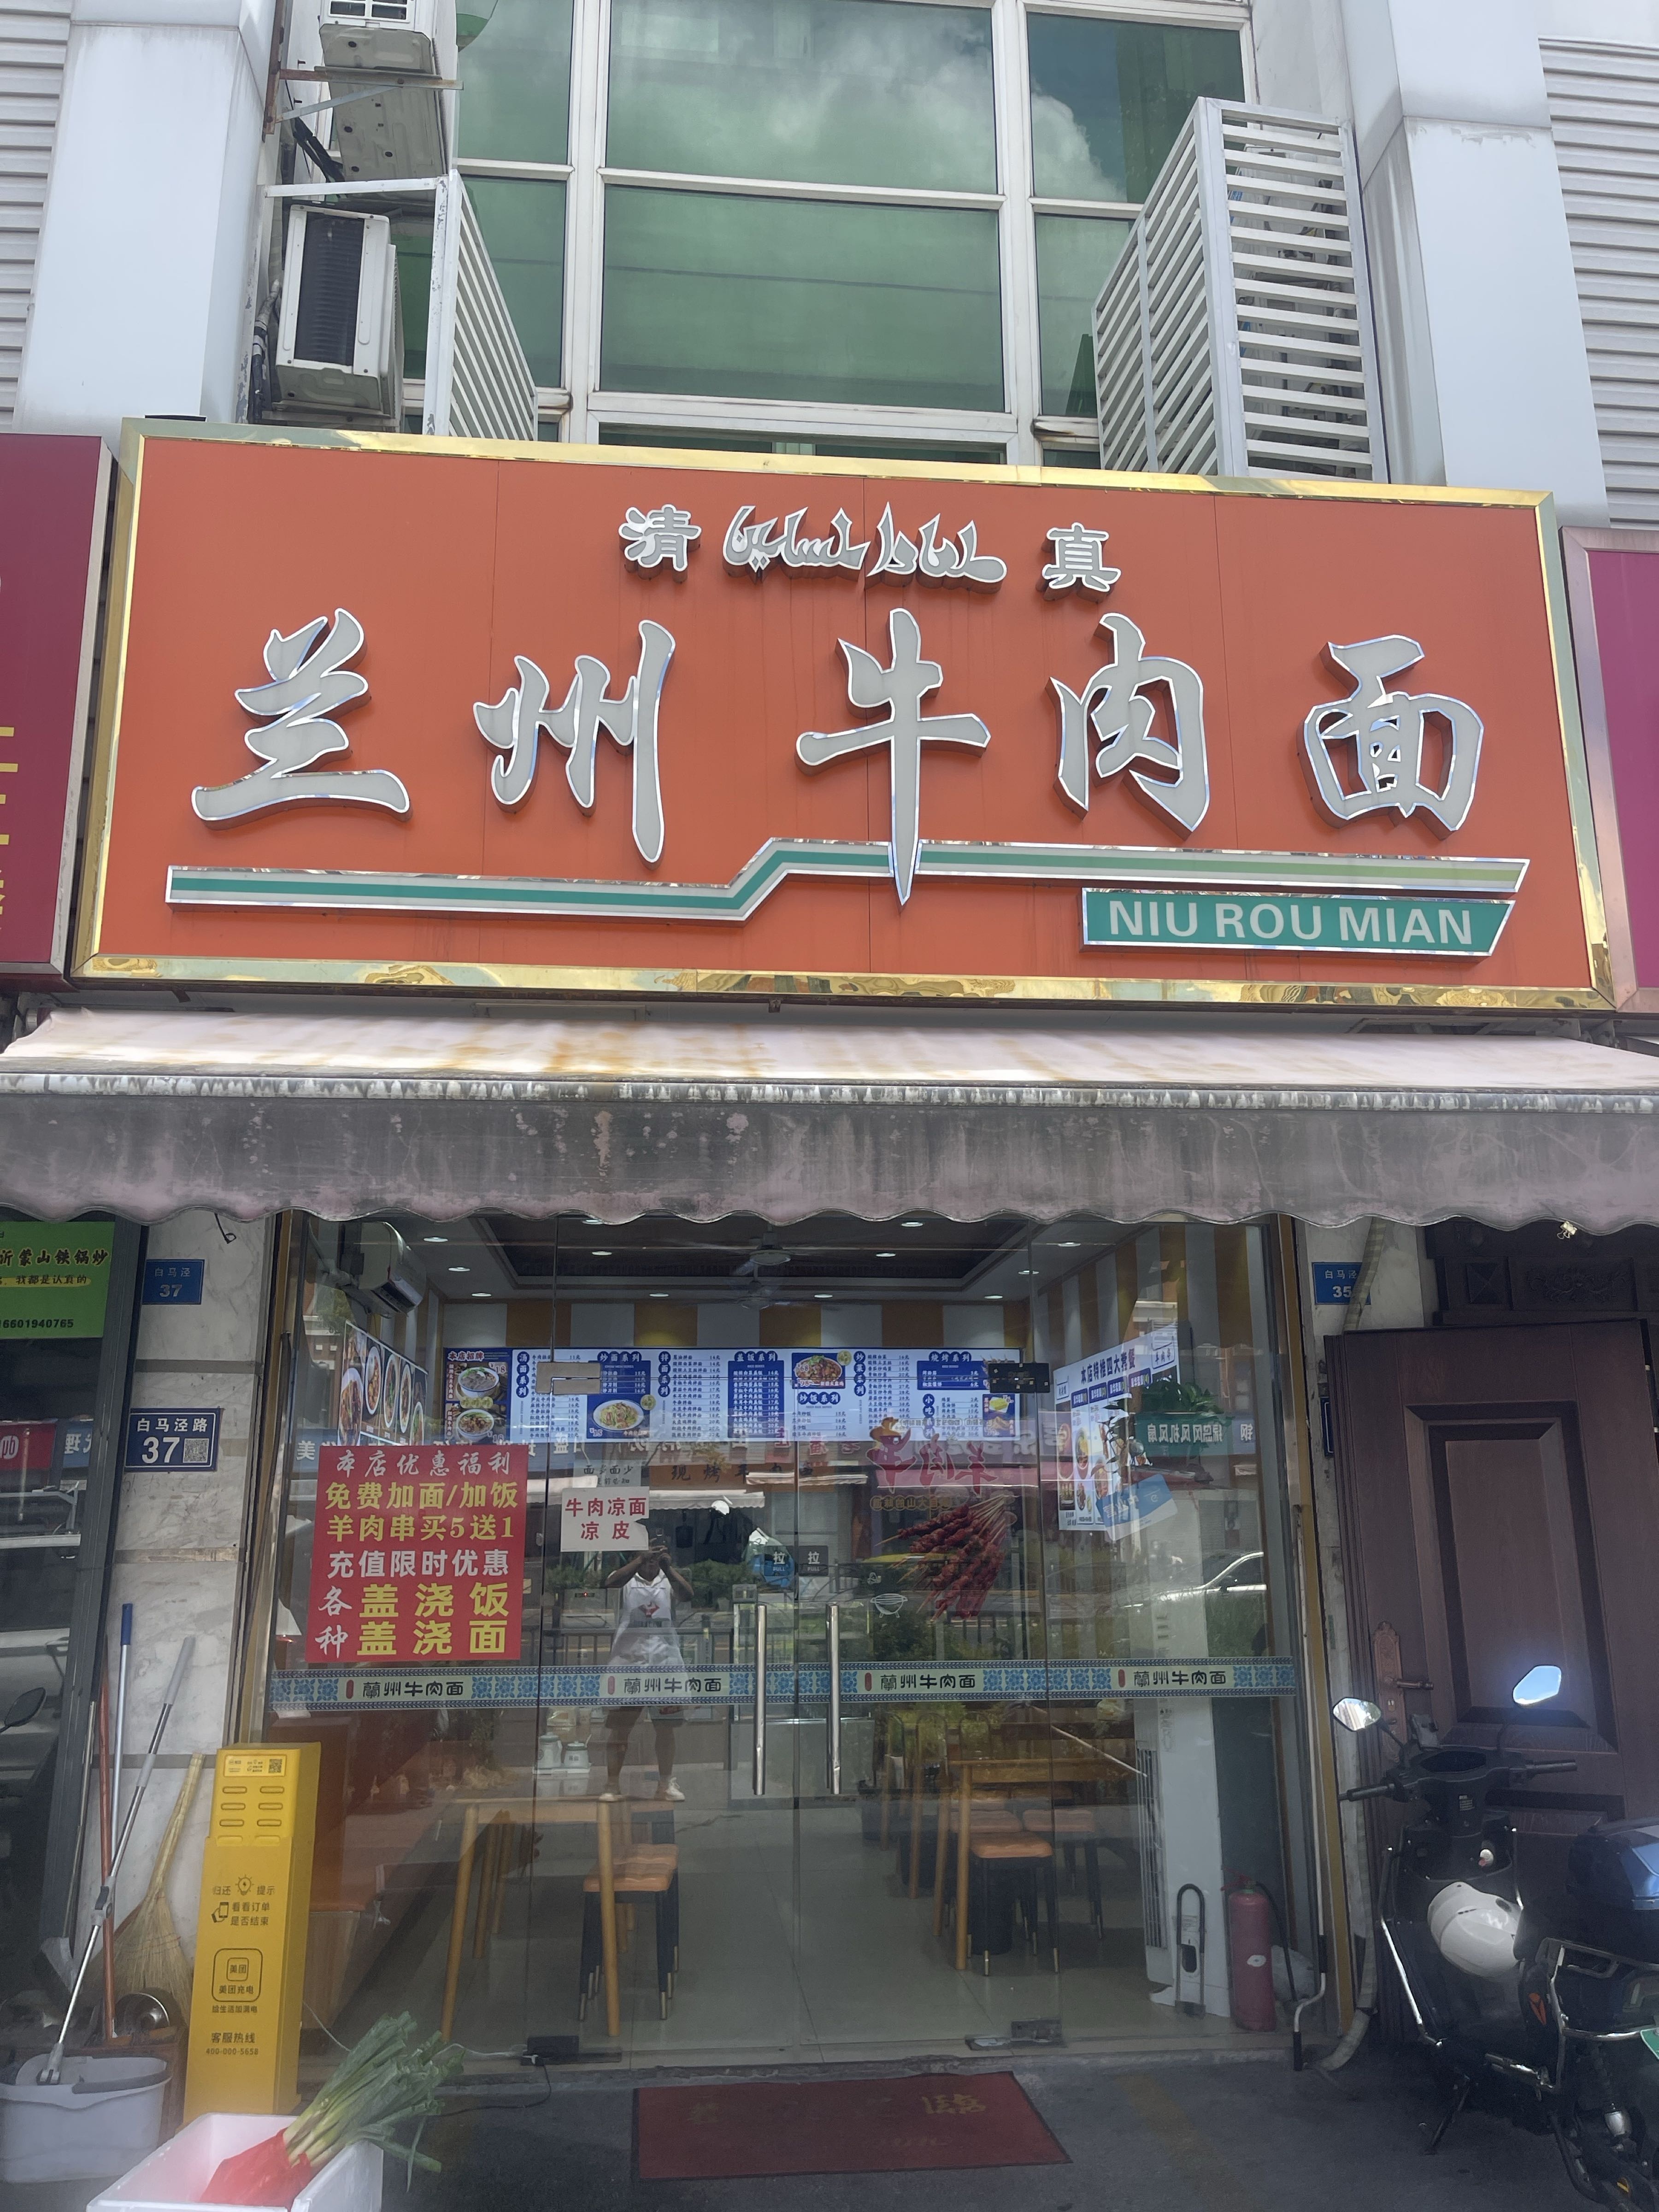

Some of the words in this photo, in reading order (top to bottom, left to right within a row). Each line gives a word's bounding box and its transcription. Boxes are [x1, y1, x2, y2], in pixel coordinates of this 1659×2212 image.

[619, 504, 702, 572] 清
[1042, 522, 1121, 592] 真
[190, 607, 1486, 907] 兰州牛肉面
[1109, 900, 1198, 936] NIU
[1215, 903, 1322, 939] ROU
[1339, 906, 1472, 944] MIAN
[154, 1267, 190, 1277] 白马泾
[16, 1274, 87, 1285] 我都是认真的
[159, 1284, 183, 1297] 37
[1332, 1285, 1352, 1298] 35
[0, 1319, 74, 1328] 6601940765
[448, 1351, 484, 1361] 本店招牌
[600, 1353, 640, 1362] 炒面系列
[931, 1353, 970, 1362] 烧烤系列
[800, 1394, 839, 1402] 炒饭系列
[136, 1418, 208, 1433] 白马泾路
[141, 1436, 181, 1464] 37
[336, 1449, 512, 1478] 本店优惠福利
[325, 1481, 519, 1511] 免费加面/加饭
[565, 1496, 647, 1518] 牛肉凉面
[327, 1513, 515, 1542] 羊肉串买5送1
[580, 1520, 631, 1541] 凉皮
[327, 1549, 510, 1579] 充值限时优惠
[773, 1551, 785, 1565] 拉
[808, 1551, 820, 1565] 拉
[359, 1582, 510, 1618] 盖浇饭
[357, 1618, 508, 1656] 盖浇面
[212, 1886, 231, 1896] 归还
[257, 1885, 275, 1895] 提示
[231, 1901, 270, 1912] 看看订单
[230, 1915, 269, 1926] 是否结束
[229, 1964, 247, 1974] 美团
[219, 1985, 253, 1994] 美团充电
[211, 2032, 256, 2043] 客服热线
